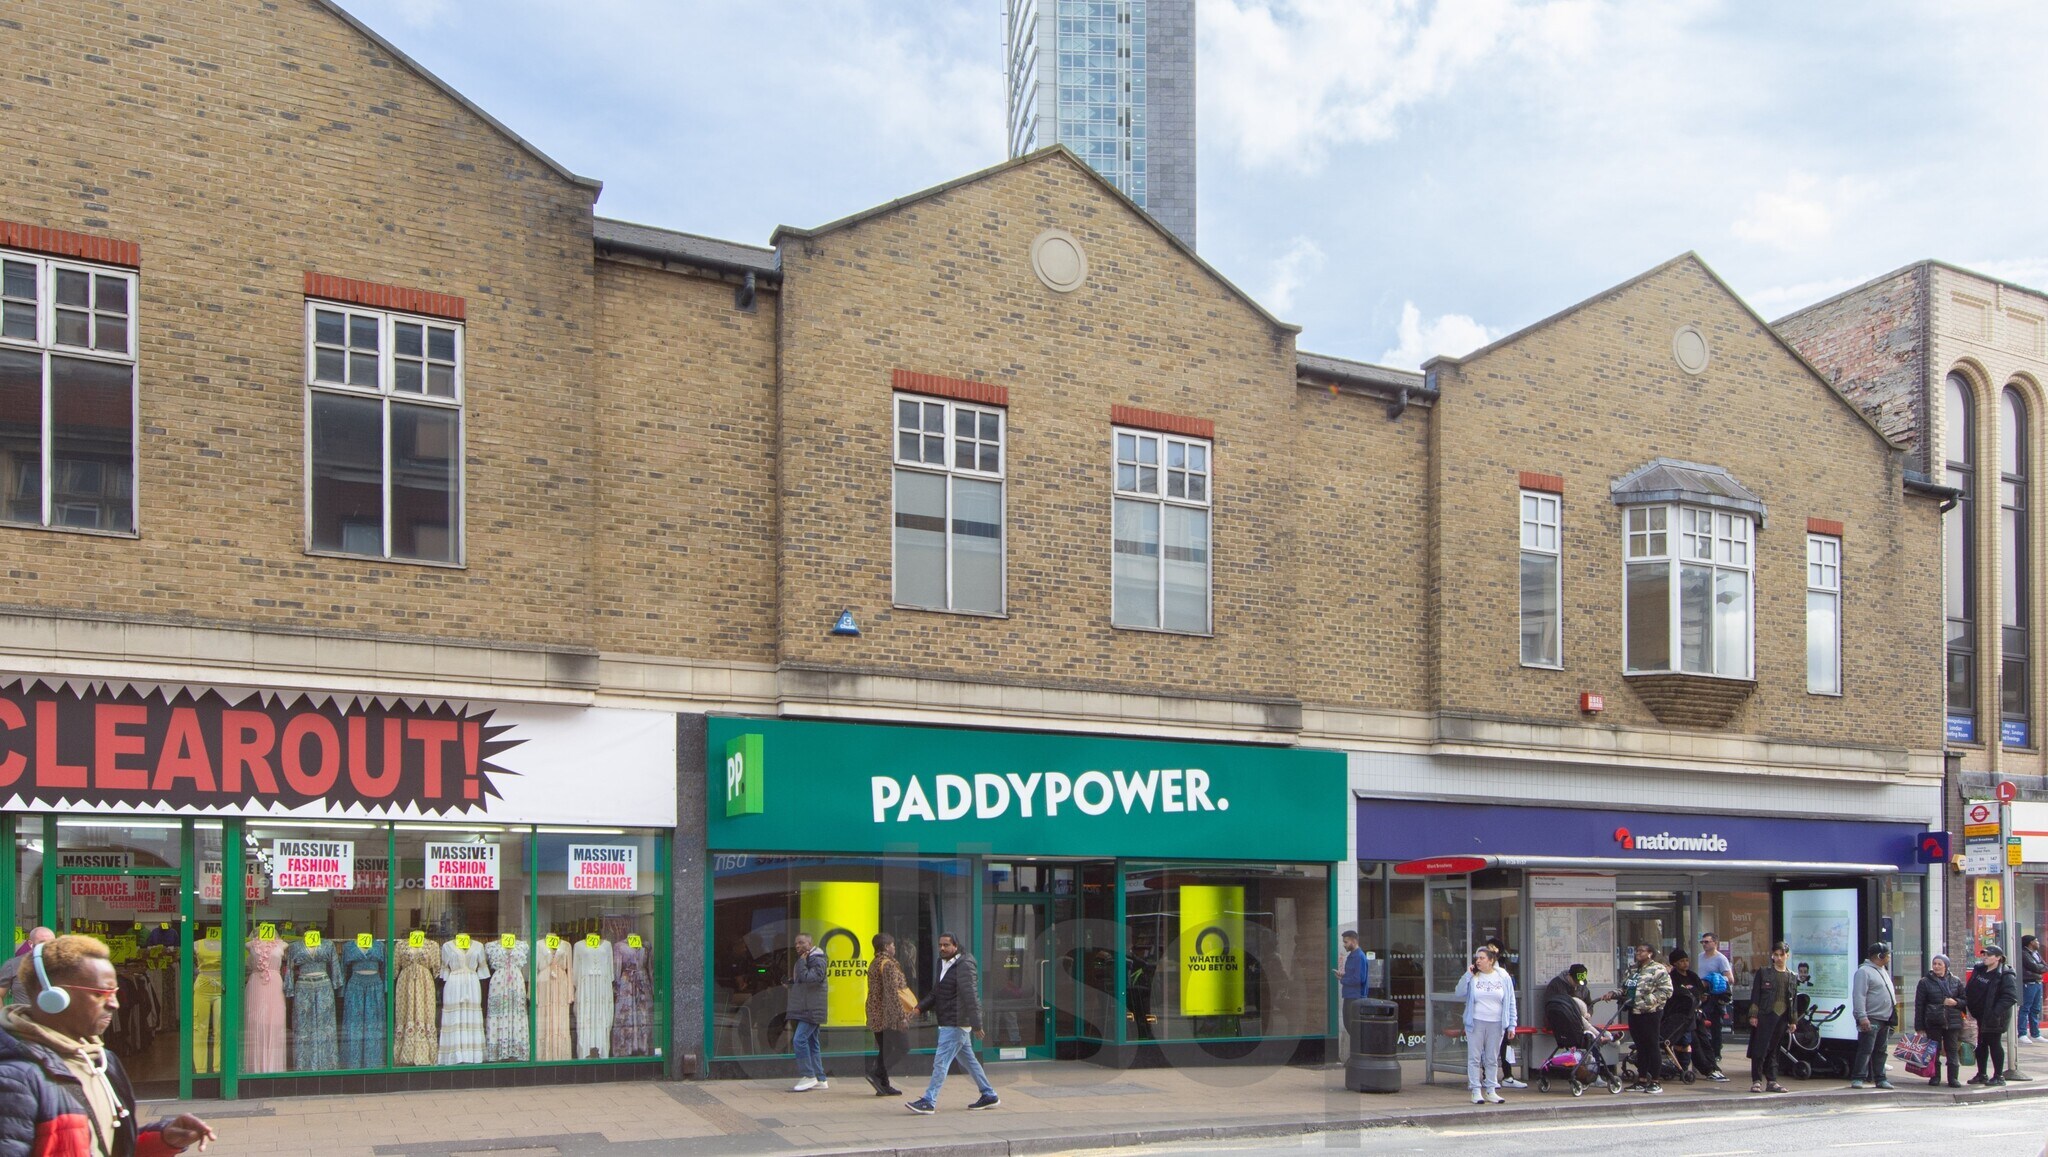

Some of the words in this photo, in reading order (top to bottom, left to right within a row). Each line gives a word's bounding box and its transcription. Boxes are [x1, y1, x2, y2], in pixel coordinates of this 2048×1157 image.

[871, 768, 1230, 823] PADDYPOWER.
[2001, 785, 2010, 798] L
[1635, 831, 1728, 852] nationwide
[280, 842, 340, 858] MASSIVE
[430, 846, 487, 860] MASSIVE
[573, 848, 626, 862] MASSIVE
[63, 855, 121, 868] MASSIVE
[287, 859, 339, 873] FASHION
[438, 860, 486, 874] FASHION
[581, 862, 625, 876] FASHION
[279, 873, 347, 889] CLEARANCE
[431, 874, 494, 889] CLEARANCE
[573, 876, 632, 890] CLEARANCE
[71, 882, 129, 896] LEARANCE
[1982, 886, 1994, 903] £1
[827, 960, 868, 968] ATEVER
[1189, 955, 1236, 963] WHATEVER
[835, 969, 853, 977] BET
[1188, 963, 1206, 971] YOU
[1208, 963, 1223, 971] BET
[1226, 963, 1238, 971] ON
[1397, 1033, 1406, 1045] A
[1408, 1035, 1426, 1047] goo
